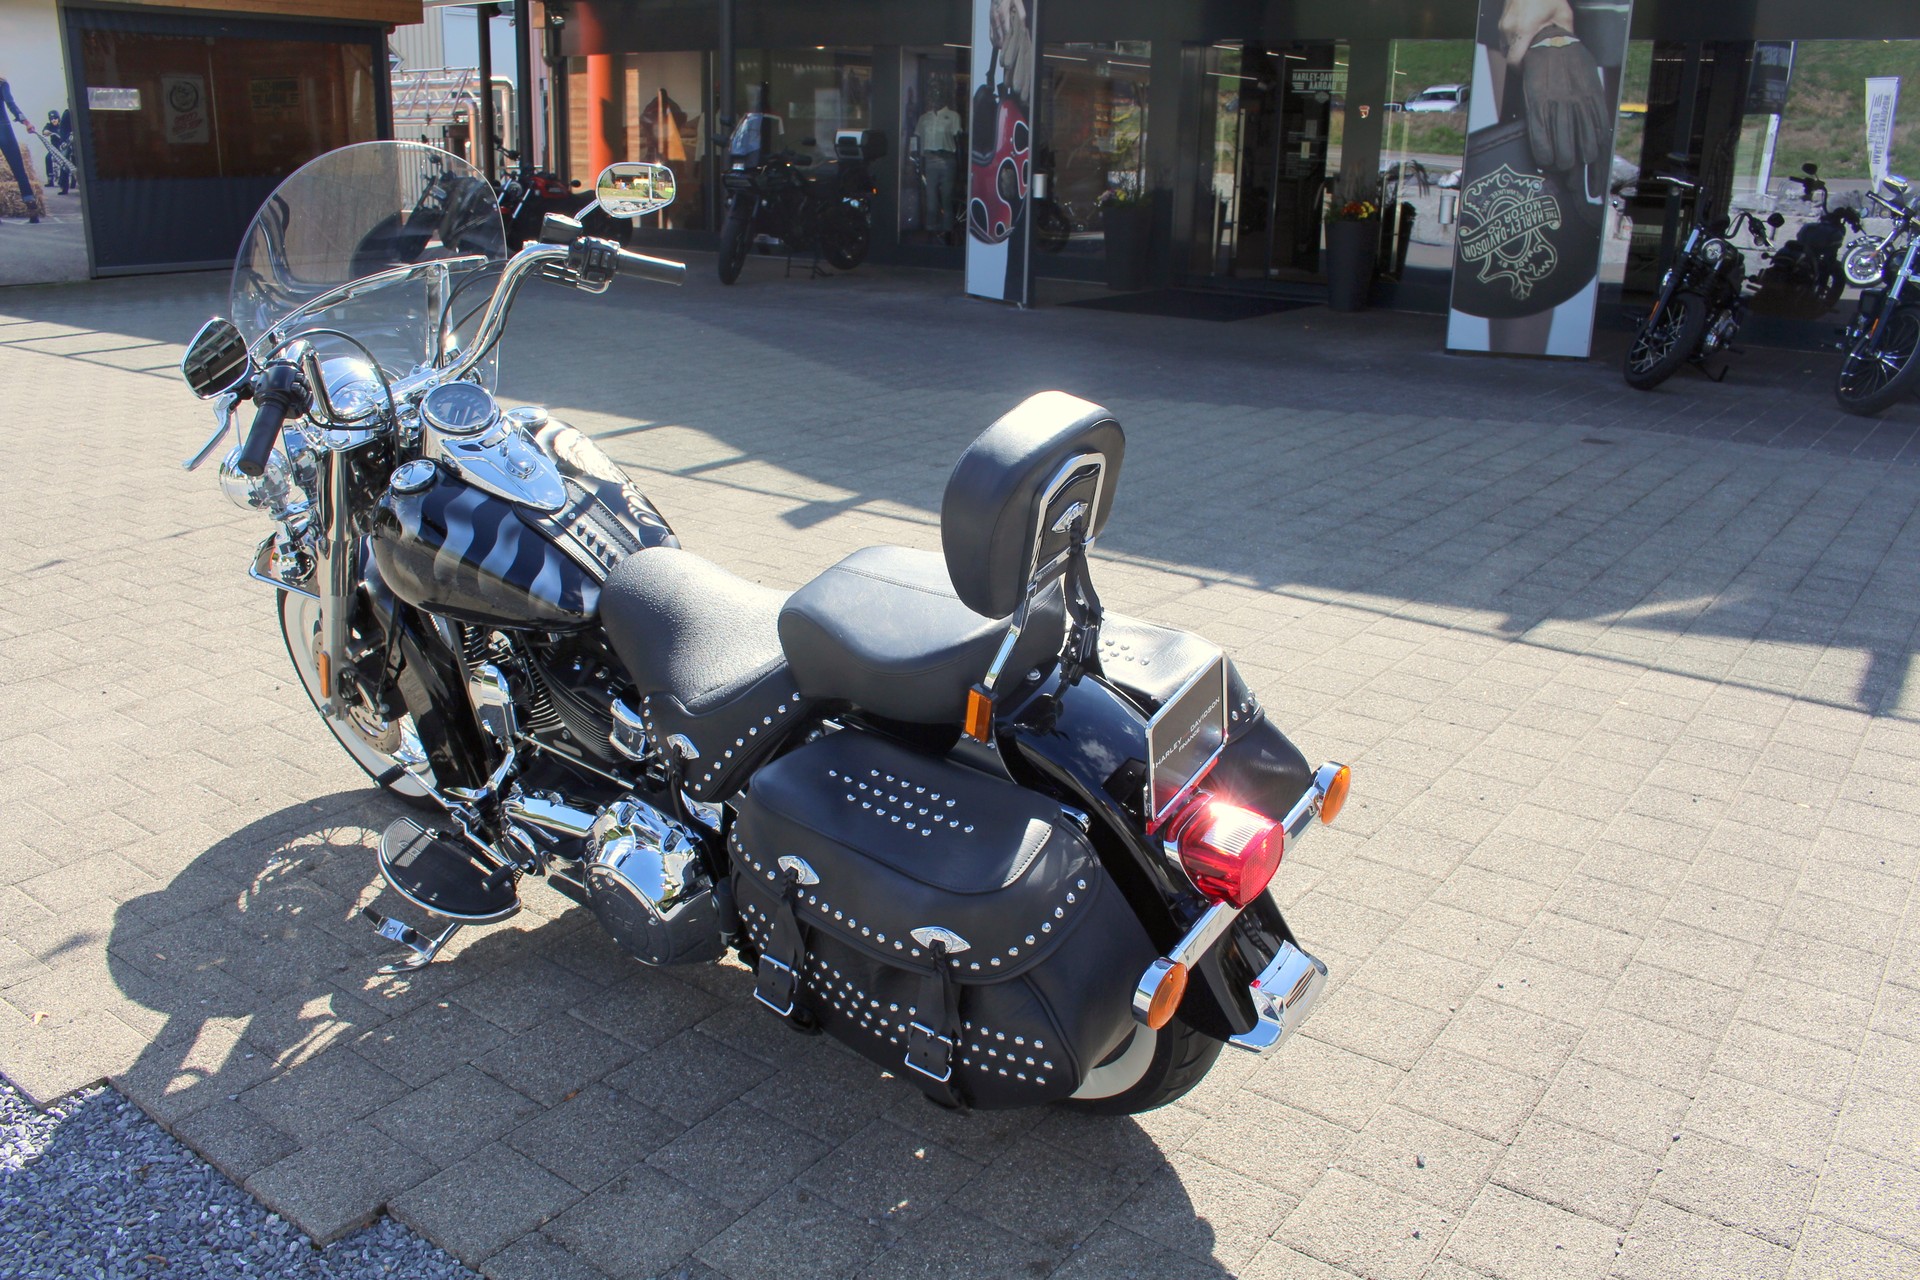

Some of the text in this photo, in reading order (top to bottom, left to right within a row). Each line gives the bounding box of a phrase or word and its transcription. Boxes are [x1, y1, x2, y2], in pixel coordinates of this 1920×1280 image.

[1308, 81, 1337, 90] AARGAU
[1503, 200, 1542, 224] MOTOR
[1464, 209, 1558, 258] THE HARLEY-DAVIDSON
[1498, 250, 1534, 269] MADE BY
[1190, 696, 1220, 732] DAVIDSON
[1178, 726, 1201, 753] FINANCE
